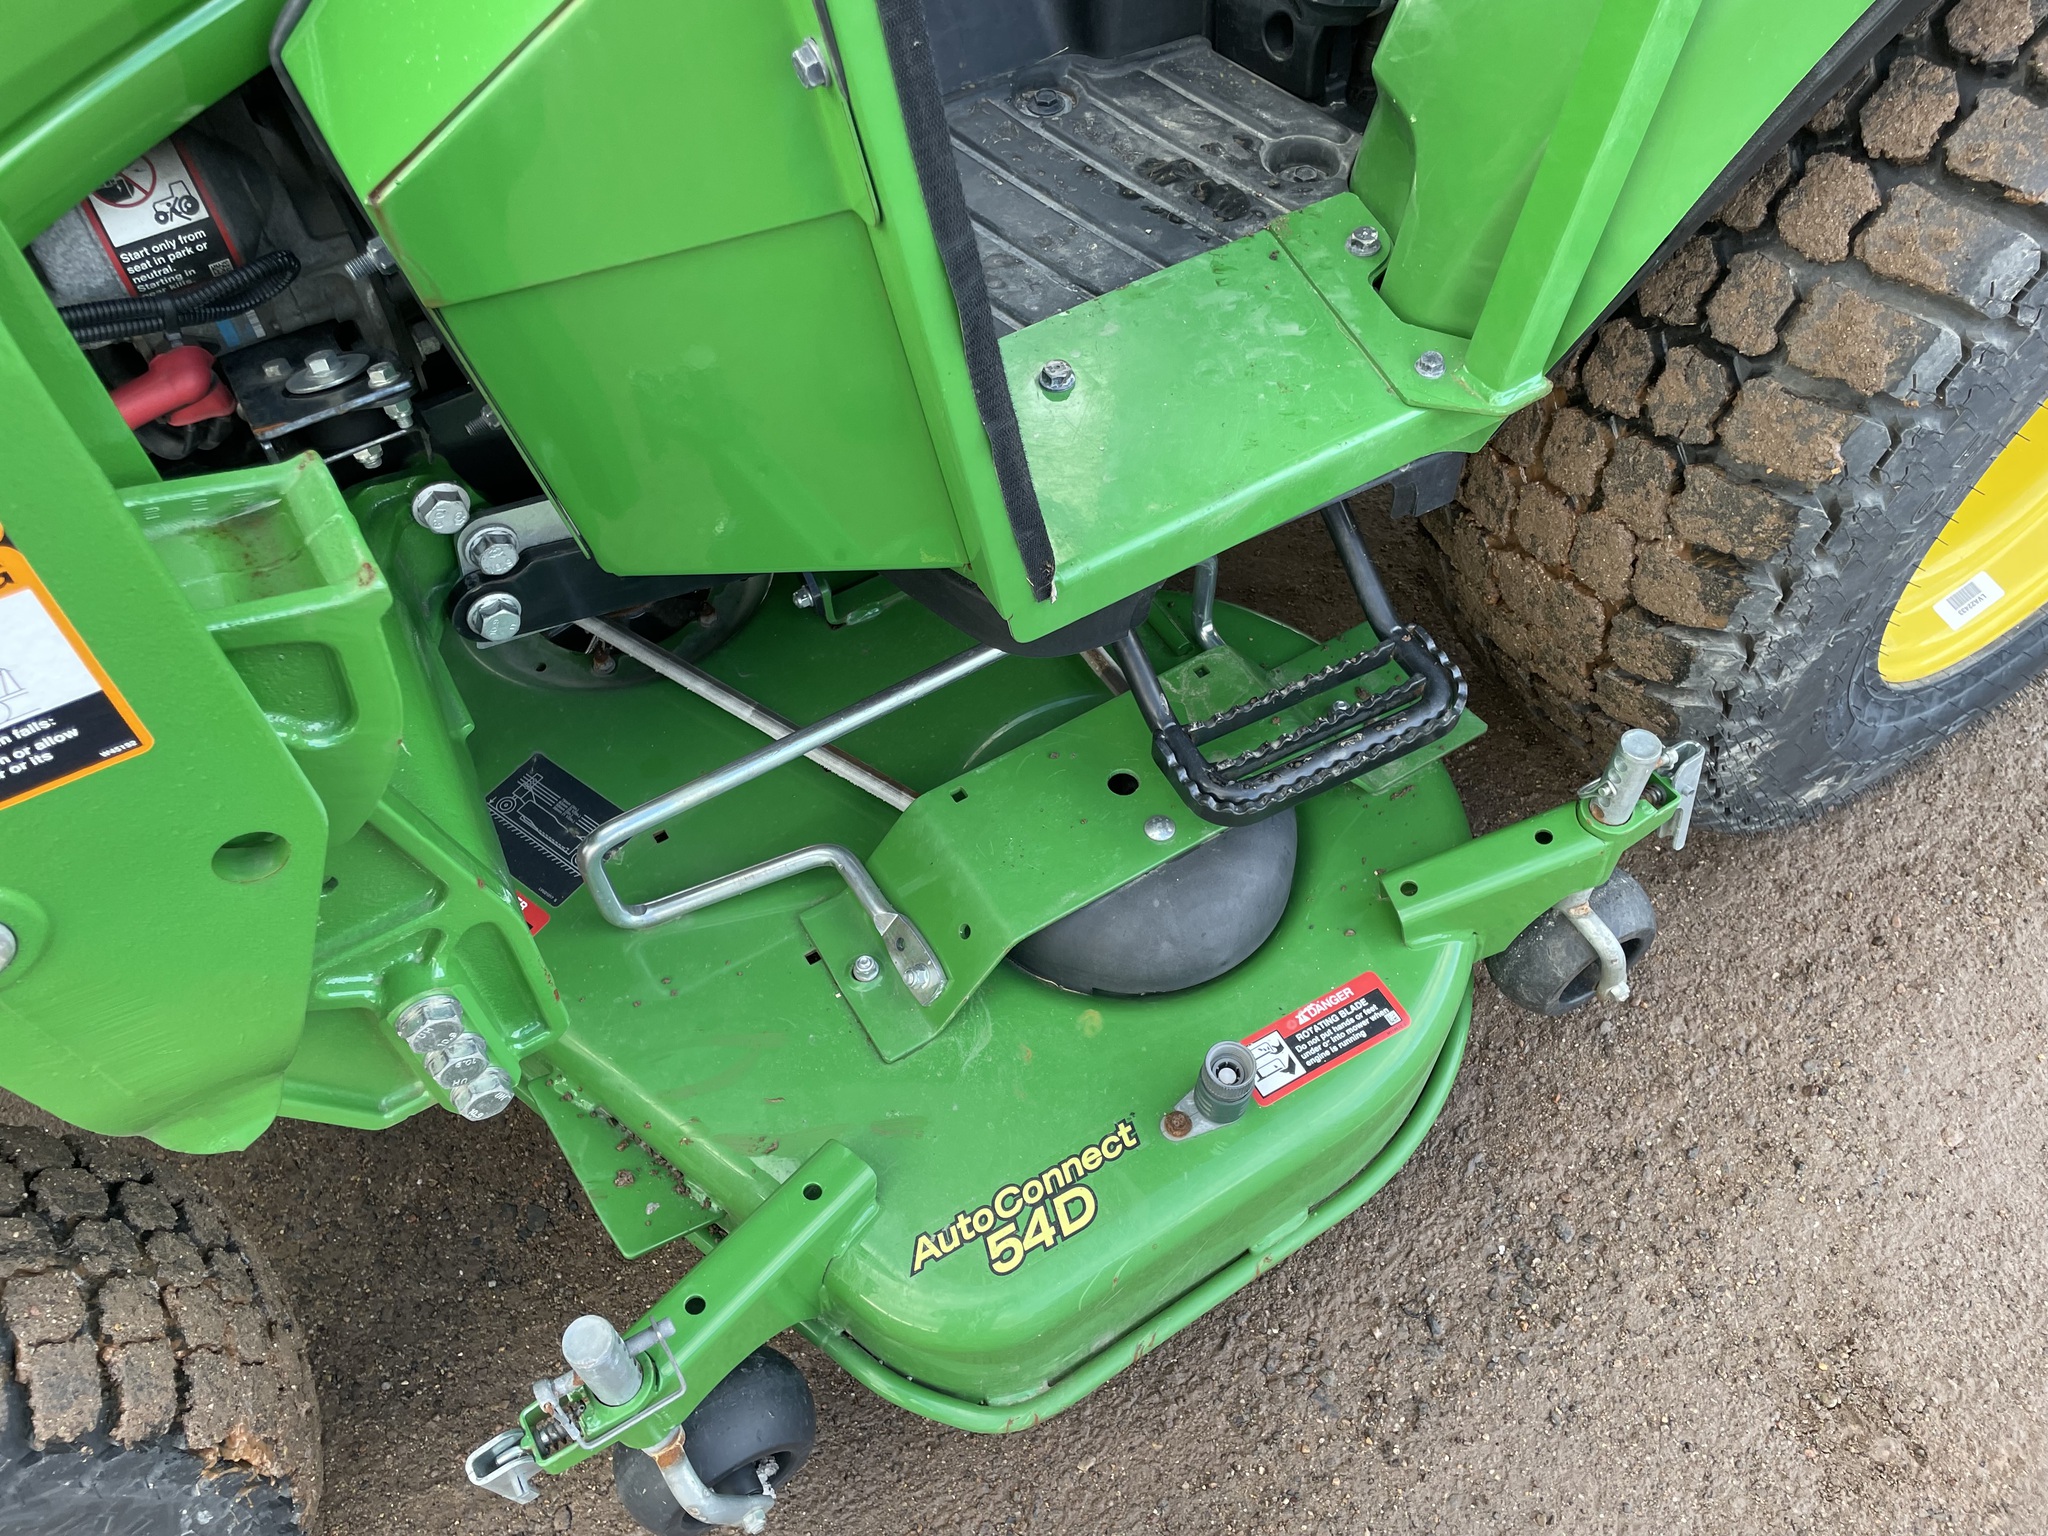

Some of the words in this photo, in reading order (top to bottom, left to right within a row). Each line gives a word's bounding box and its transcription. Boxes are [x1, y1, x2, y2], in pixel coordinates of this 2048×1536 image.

[120, 247, 150, 263] Start
[151, 239, 176, 253] only
[178, 229, 206, 244] from
[127, 260, 153, 274] seat
[153, 256, 166, 265] in
[167, 246, 194, 263] park
[195, 241, 208, 251] or
[132, 264, 177, 284] neutral.
[137, 274, 183, 292] Starting
[184, 269, 196, 277] in
[1957, 593, 1987, 616] LVA22433
[12, 718, 57, 739] falls:
[12, 746, 31, 759] or
[34, 728, 79, 751] allow
[9, 761, 28, 774] or
[29, 752, 54, 766] its
[1307, 987, 1354, 1017] DANGER
[1295, 1014, 1340, 1042] ROTATING
[1338, 998, 1369, 1019] BLADE
[1295, 1043, 1308, 1053] Do
[1307, 1036, 1321, 1047] not
[1320, 1028, 1334, 1041] put
[1332, 1017, 1355, 1032] hands
[1355, 1012, 1364, 1020] or
[1362, 1004, 1379, 1016] feet
[1301, 1044, 1322, 1060] under
[1330, 1032, 1346, 1043] into
[1345, 1018, 1370, 1035] mower
[1369, 1007, 1390, 1022] when
[437, 1032, 458, 1047] 10.9
[1306, 1049, 1331, 1066] engine
[1329, 1045, 1339, 1053] is
[1337, 1030, 1367, 1048] running
[910, 1117, 1141, 1277] AutoConnect
[982, 1183, 1098, 1276] 54D
